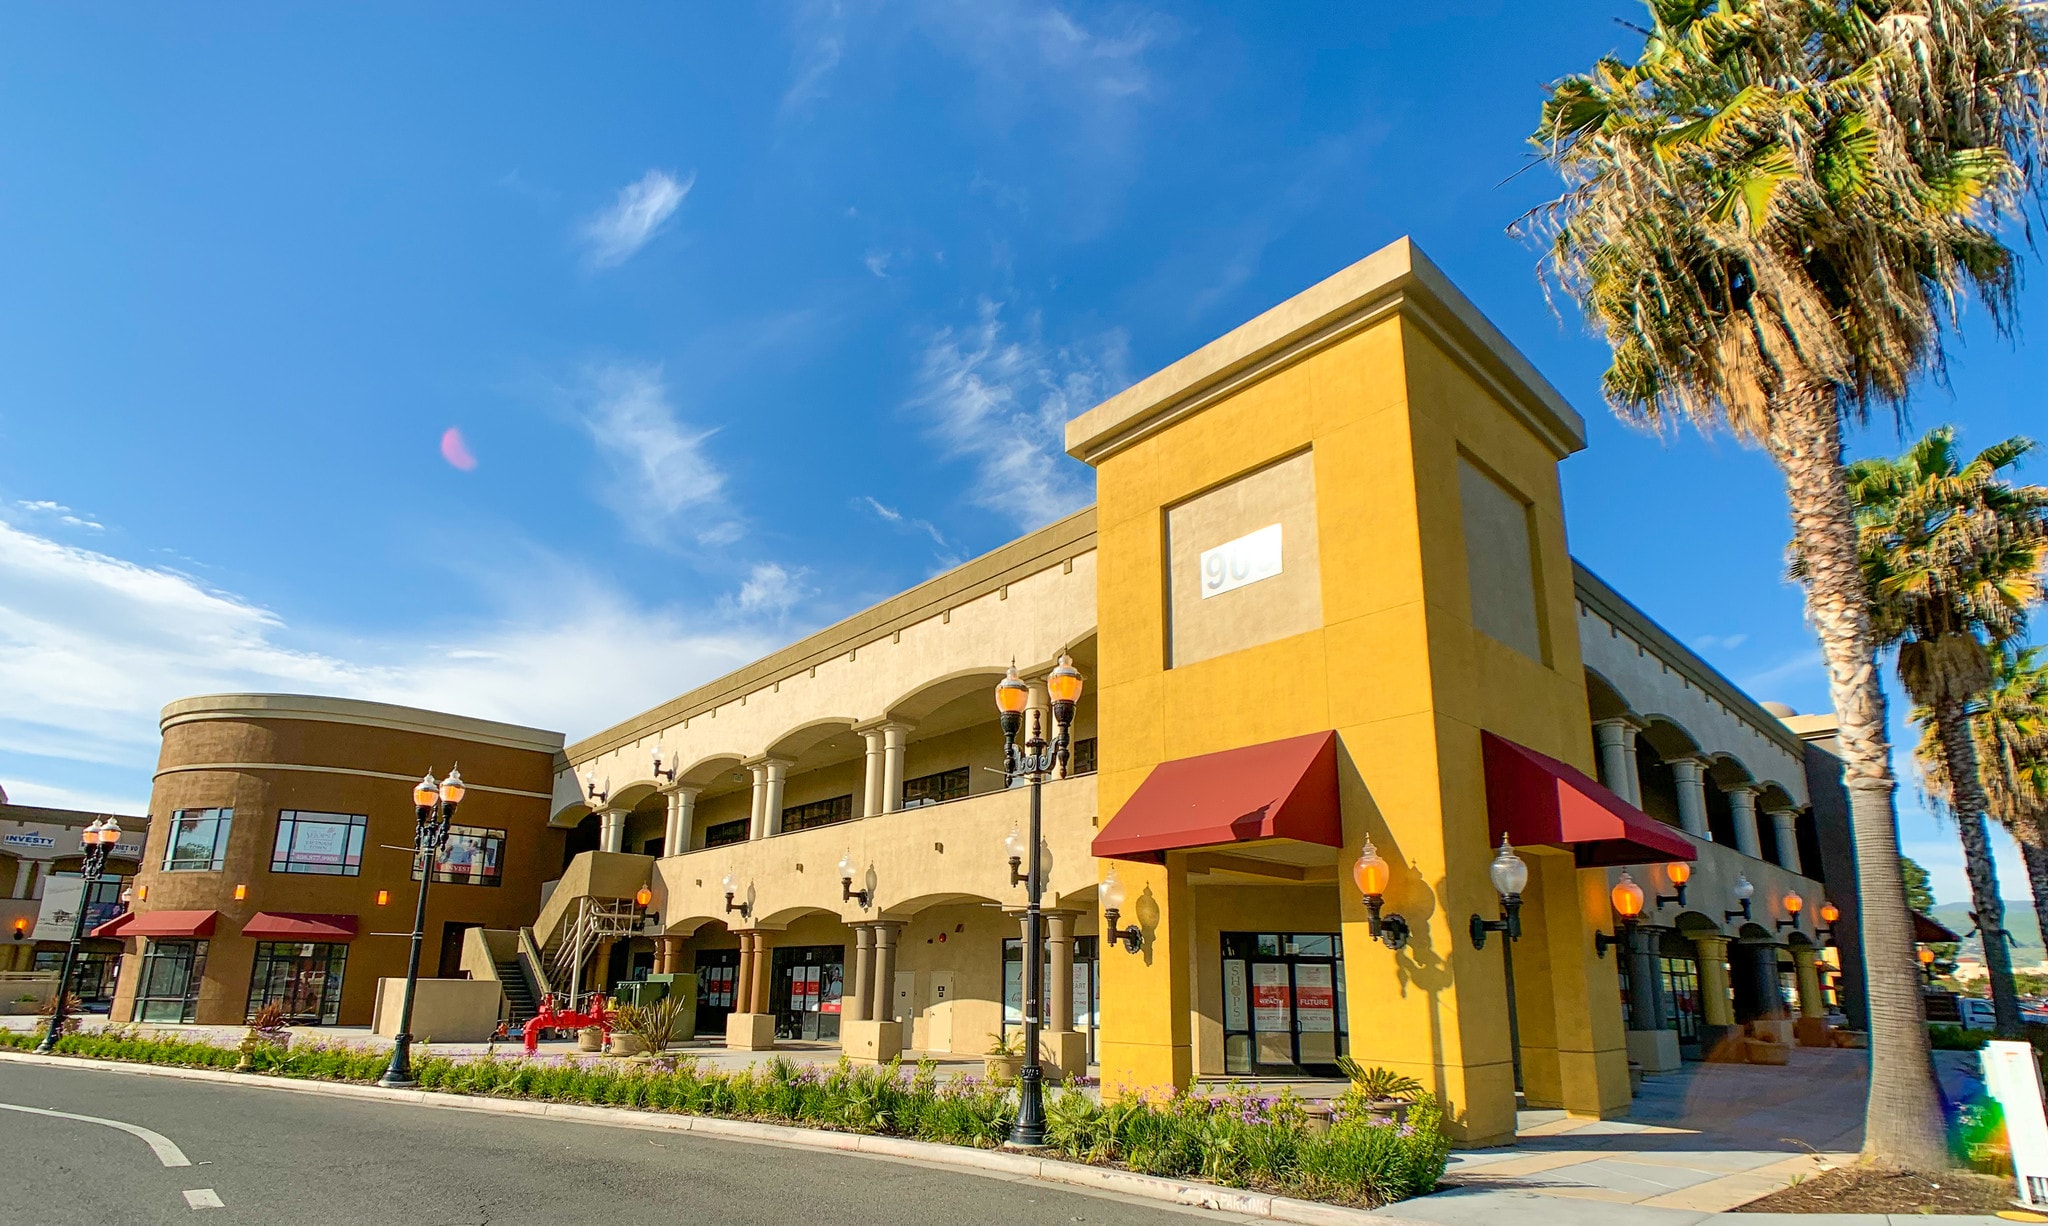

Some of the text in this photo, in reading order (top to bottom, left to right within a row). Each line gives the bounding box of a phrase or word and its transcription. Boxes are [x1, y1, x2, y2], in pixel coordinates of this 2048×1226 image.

[1206, 541, 1274, 589] 90
[5, 835, 54, 845] INVESTY
[1231, 966, 1242, 1018] SHOPS
[1300, 998, 1329, 1006] FUTURE
